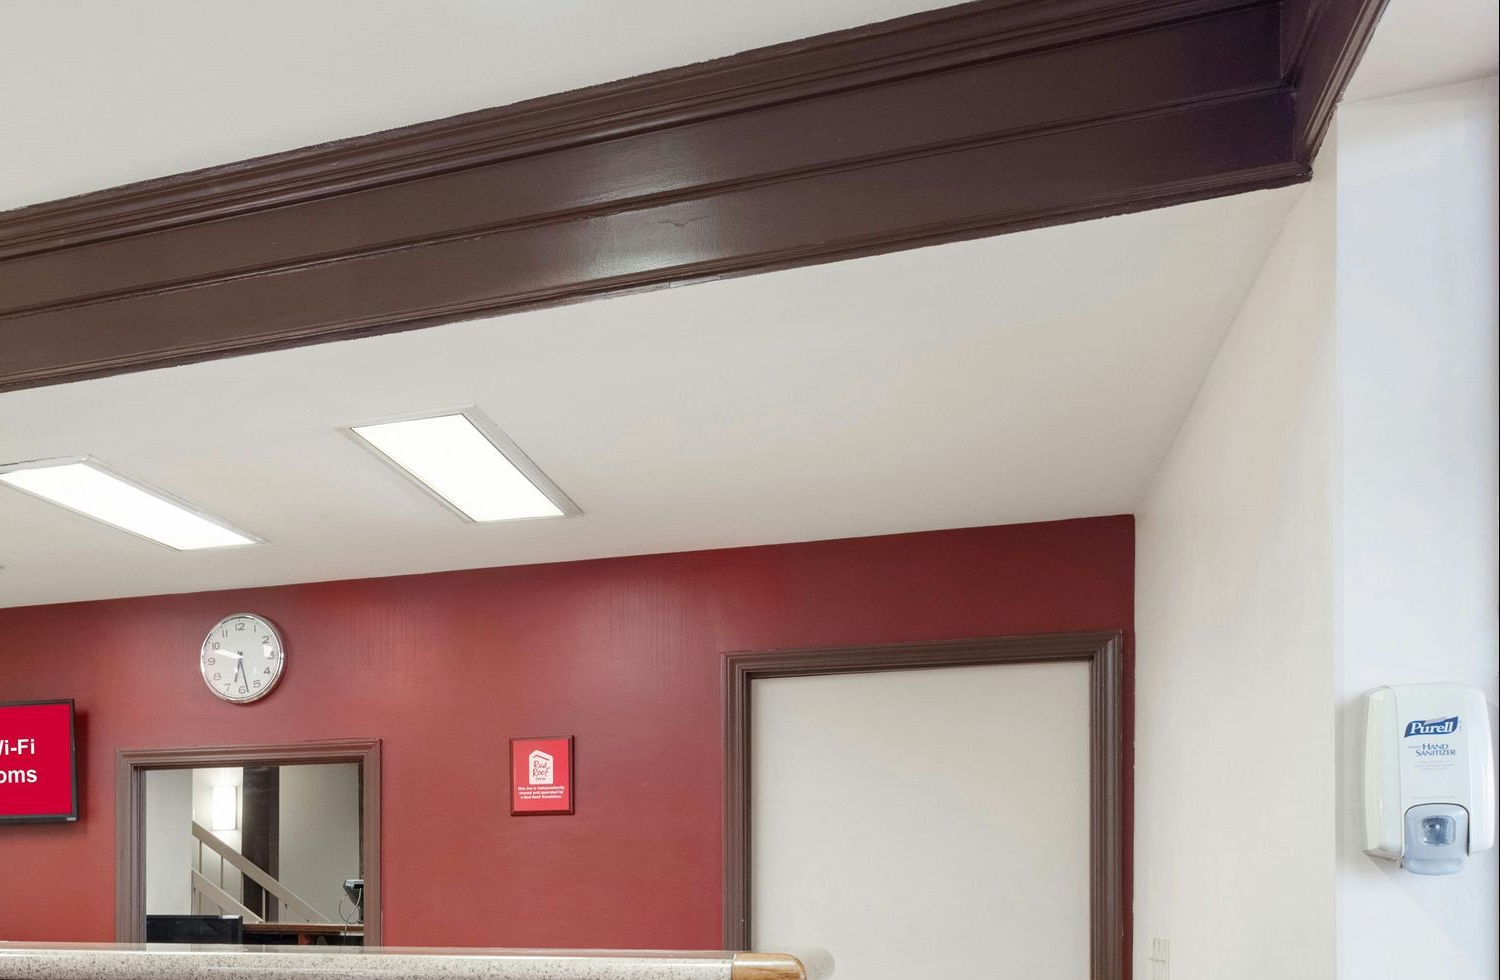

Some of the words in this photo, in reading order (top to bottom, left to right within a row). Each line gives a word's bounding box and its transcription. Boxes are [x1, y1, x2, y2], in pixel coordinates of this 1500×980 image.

[235, 623, 245, 631] 12
[222, 629, 229, 638] 11
[262, 635, 270, 645] 2
[211, 642, 220, 650] 10
[267, 651, 275, 660] 3
[264, 667, 271, 675] 4
[224, 683, 231, 692] 7
[253, 680, 261, 688] 5
[239, 686, 246, 694] 6
[1409, 721, 1454, 734] Purell
[533, 760, 548, 769] Red
[532, 767, 550, 778] Roof
